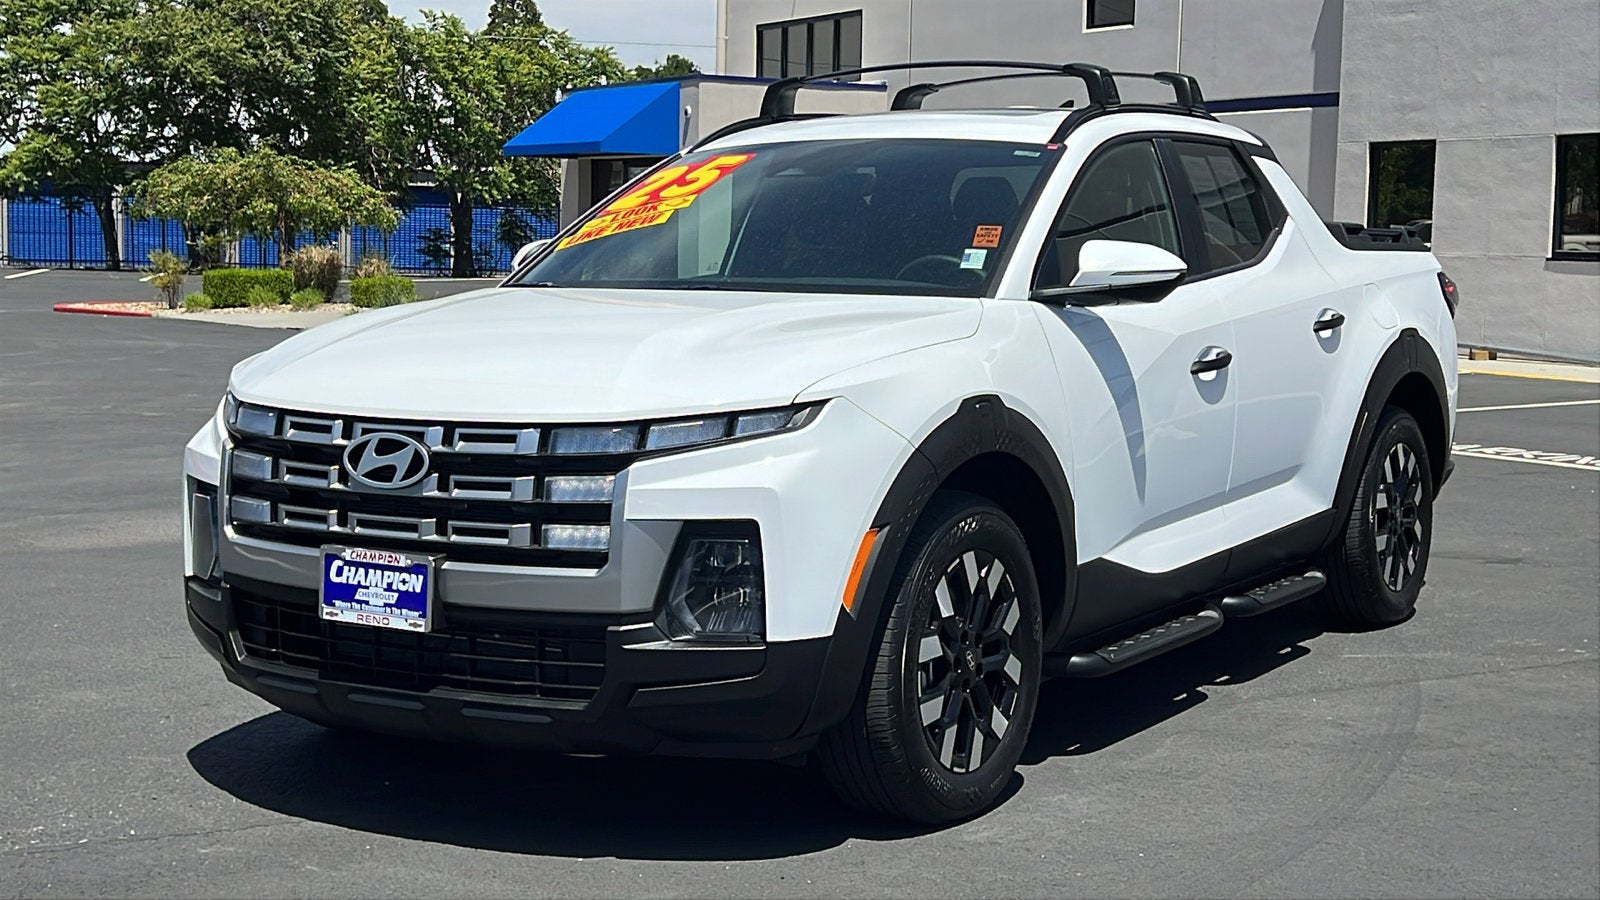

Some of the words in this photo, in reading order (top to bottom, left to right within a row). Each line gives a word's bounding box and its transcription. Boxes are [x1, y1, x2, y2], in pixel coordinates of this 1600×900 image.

[605, 154, 750, 212] 25
[608, 202, 660, 223] LOOK
[564, 225, 612, 246] LIKE
[610, 212, 663, 234] NEW
[350, 550, 401, 565] CHAMPION
[329, 559, 424, 593] CHAMPION
[357, 590, 395, 601] CHEVROLET
[356, 613, 390, 626] RENO
